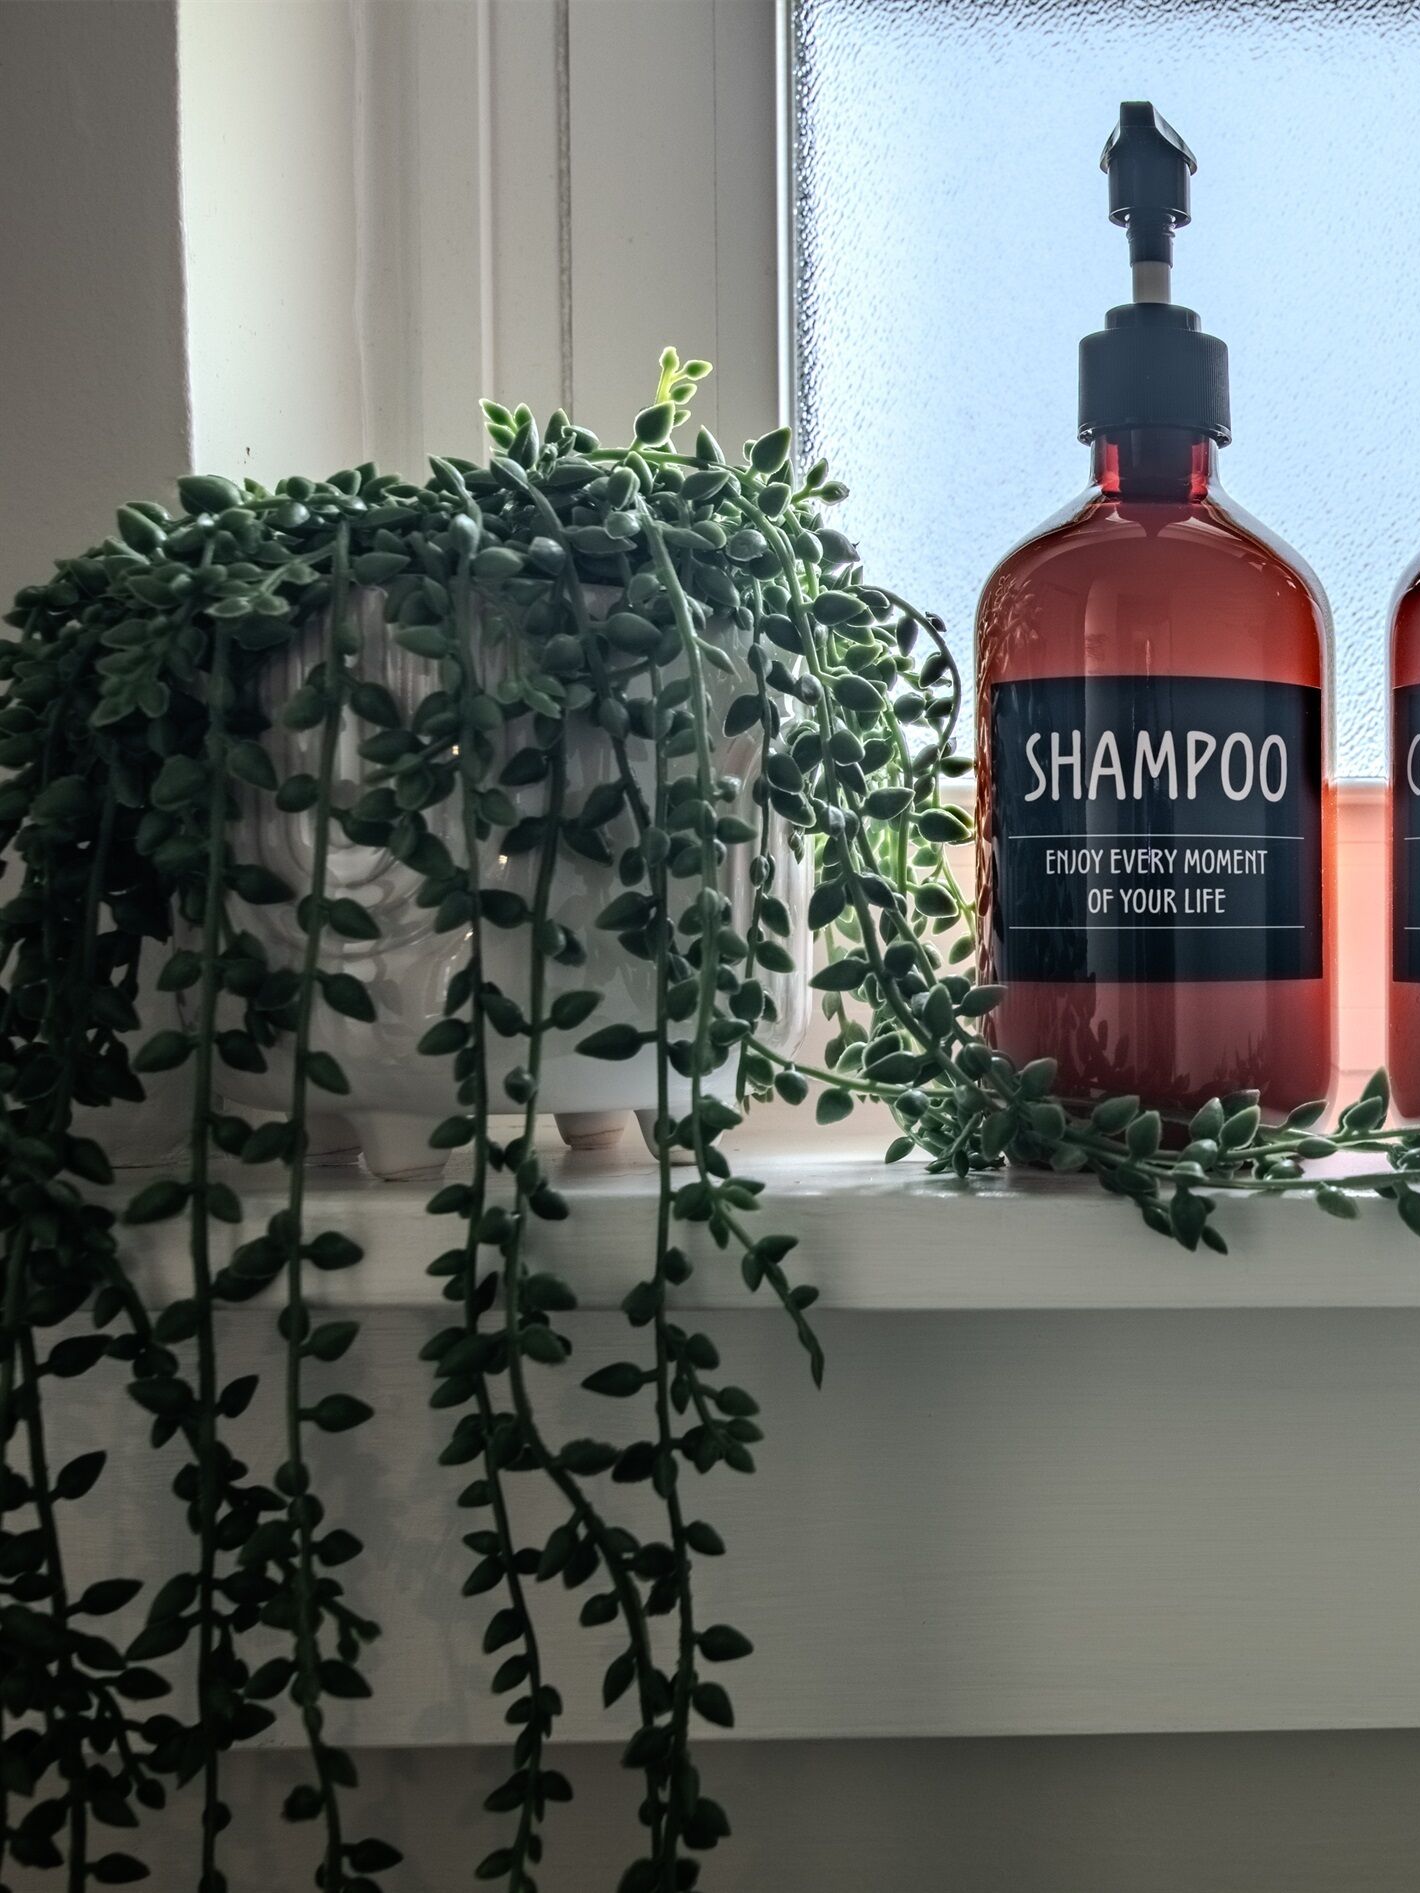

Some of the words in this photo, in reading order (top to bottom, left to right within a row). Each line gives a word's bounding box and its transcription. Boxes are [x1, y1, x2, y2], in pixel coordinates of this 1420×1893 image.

[1024, 729, 1288, 803] SHAMPOO
[1045, 848, 1104, 875] ENJOY
[1110, 848, 1178, 875] EVERY
[1183, 848, 1268, 875] MOMENT
[1087, 887, 1115, 914] OF
[1119, 887, 1178, 915] YOUR
[1184, 887, 1227, 914] LIFE
